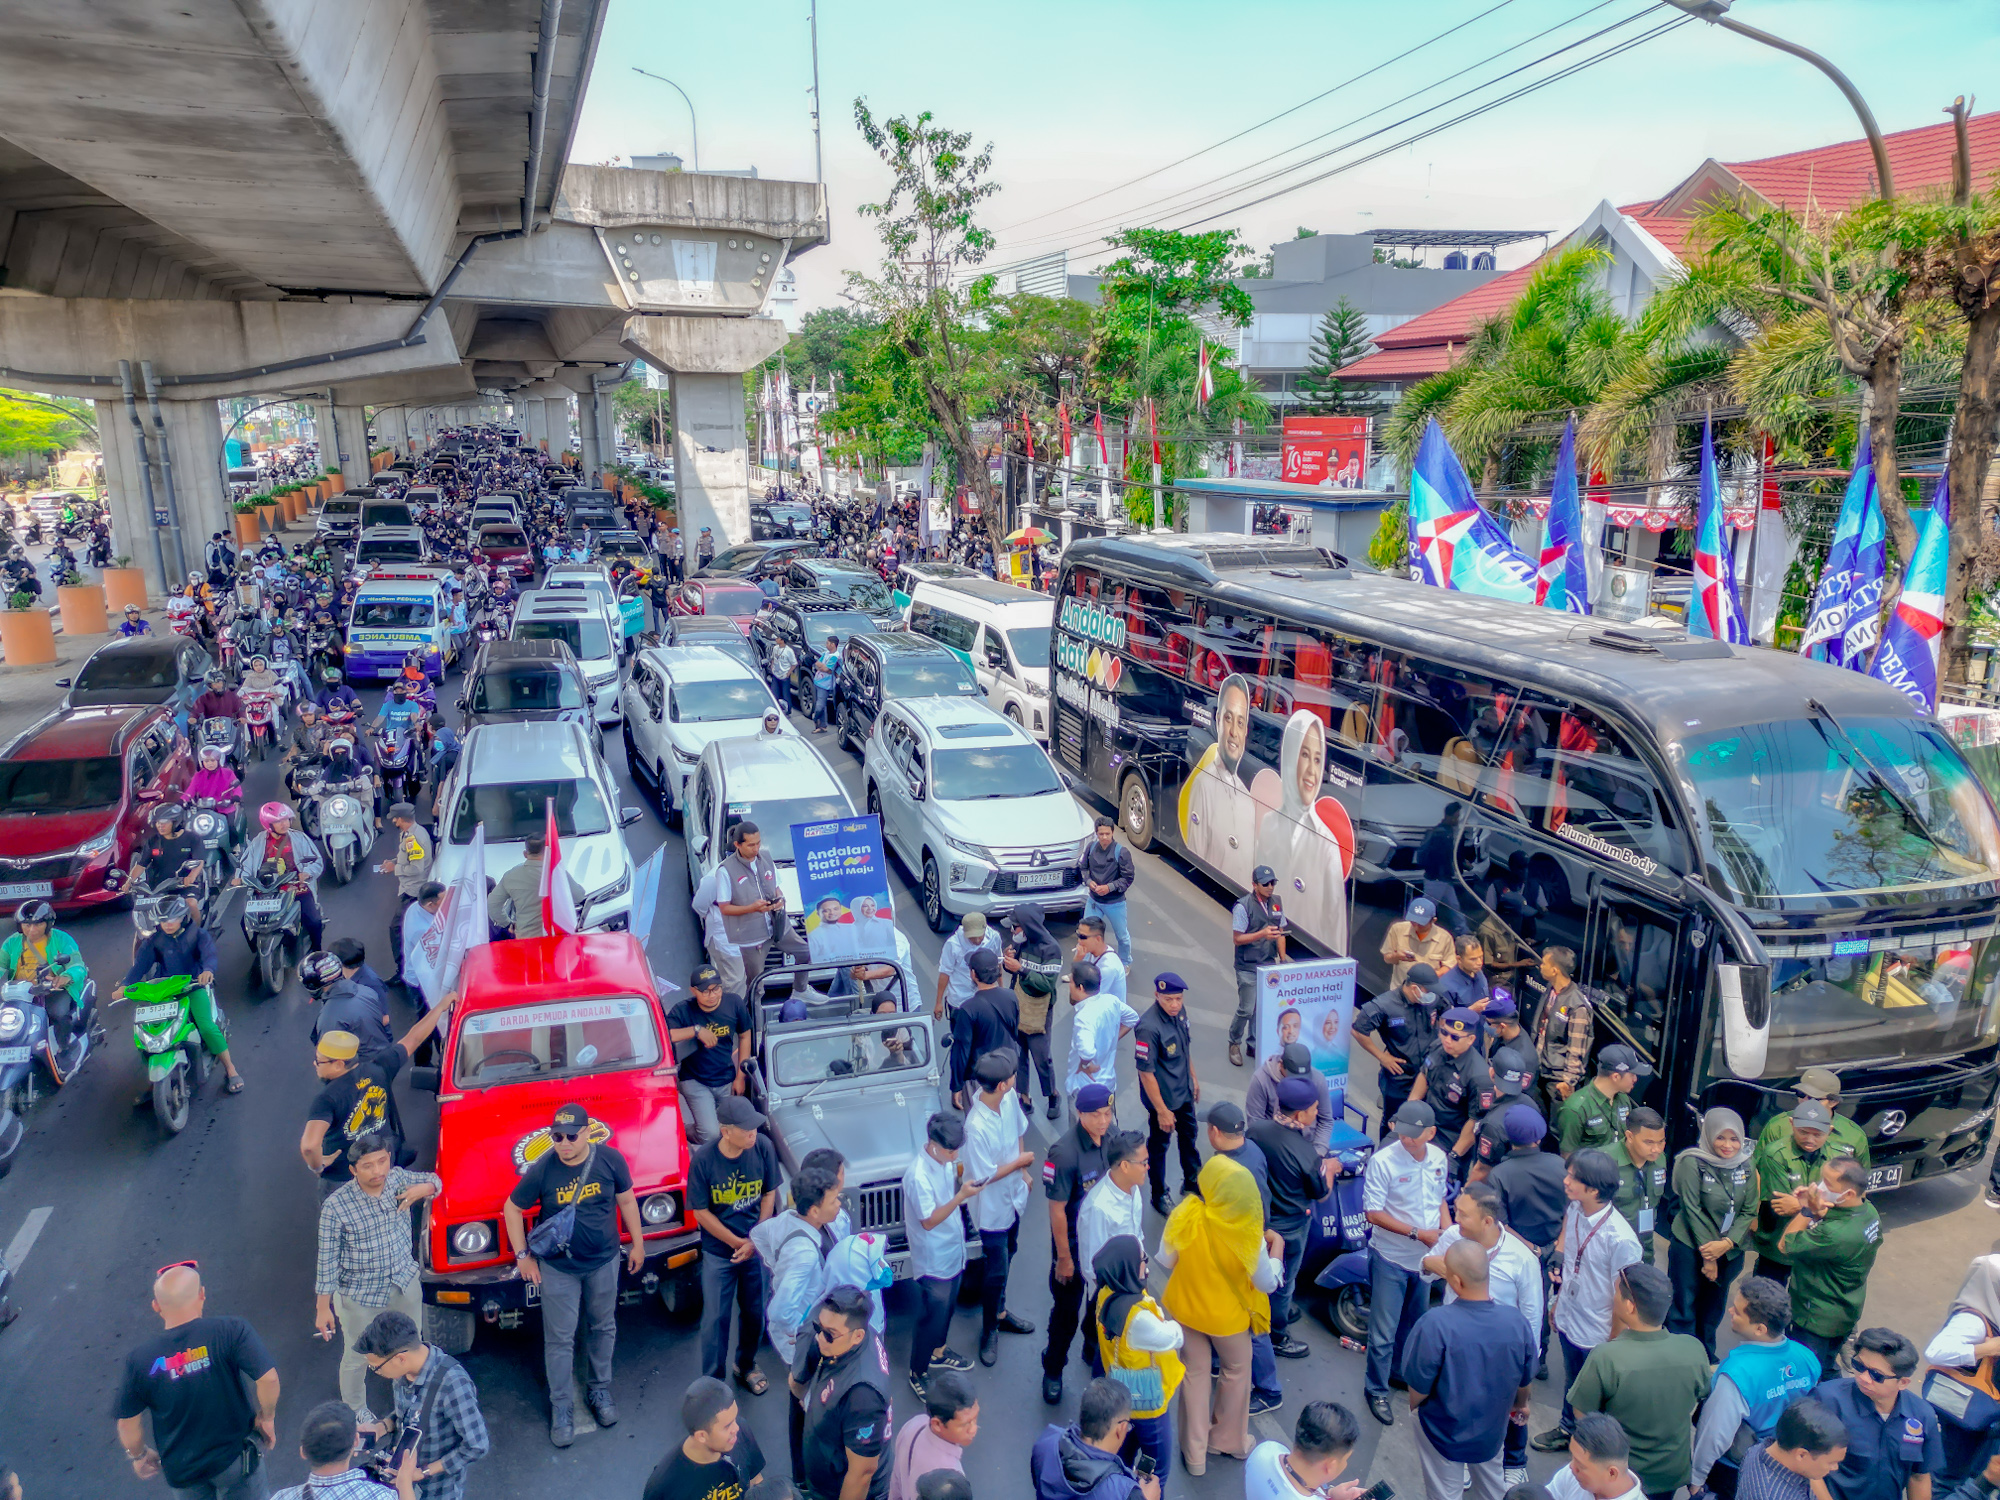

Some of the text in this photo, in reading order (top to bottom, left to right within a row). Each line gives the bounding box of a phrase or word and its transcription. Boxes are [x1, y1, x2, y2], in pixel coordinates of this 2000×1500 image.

[1060, 595, 1126, 649] Andalan
[1057, 632, 1089, 677] Hati
[807, 845, 871, 861] Andalan
[808, 856, 840, 871] Hati
[810, 865, 875, 881] Sulsel Maju
[12, 884, 31, 893] 1338
[1283, 967, 1354, 983] DPD MAKASSAR
[1276, 981, 1343, 998] Andalan Hati
[1298, 996, 1321, 1005] Sulsel
[150, 1005, 166, 1013] 5133
[500, 1005, 612, 1027] GARDA PEMUDA ANDALAN
[1886, 1169, 1898, 1182] CA
[1322, 1215, 1336, 1227] GP
